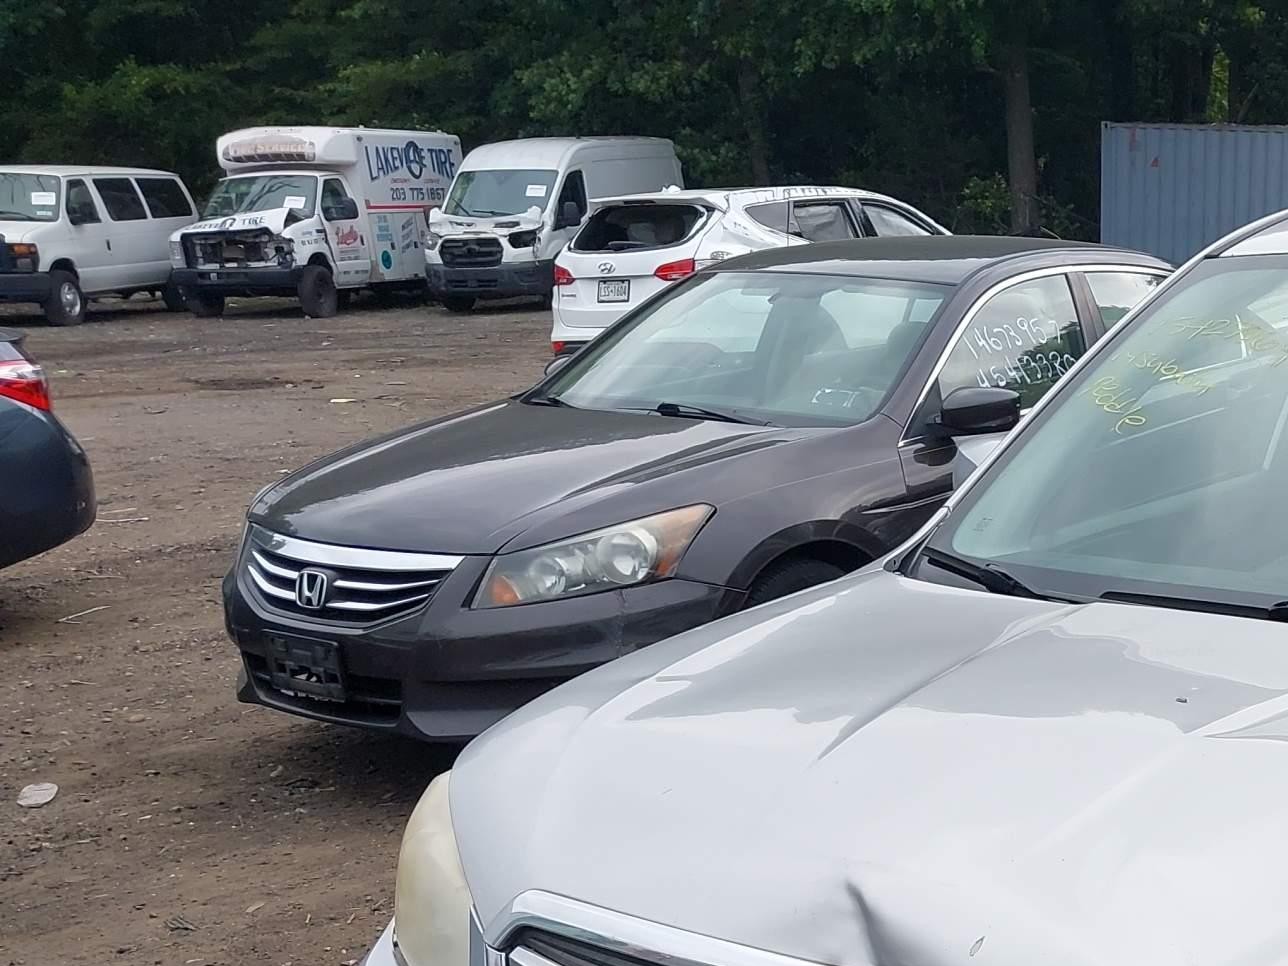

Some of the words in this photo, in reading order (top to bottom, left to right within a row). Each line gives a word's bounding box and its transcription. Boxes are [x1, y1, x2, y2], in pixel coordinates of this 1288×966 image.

[427, 148, 455, 181] TIRE
[391, 187, 406, 201] 203
[409, 187, 424, 201] 775
[963, 316, 1062, 360] 14673957
